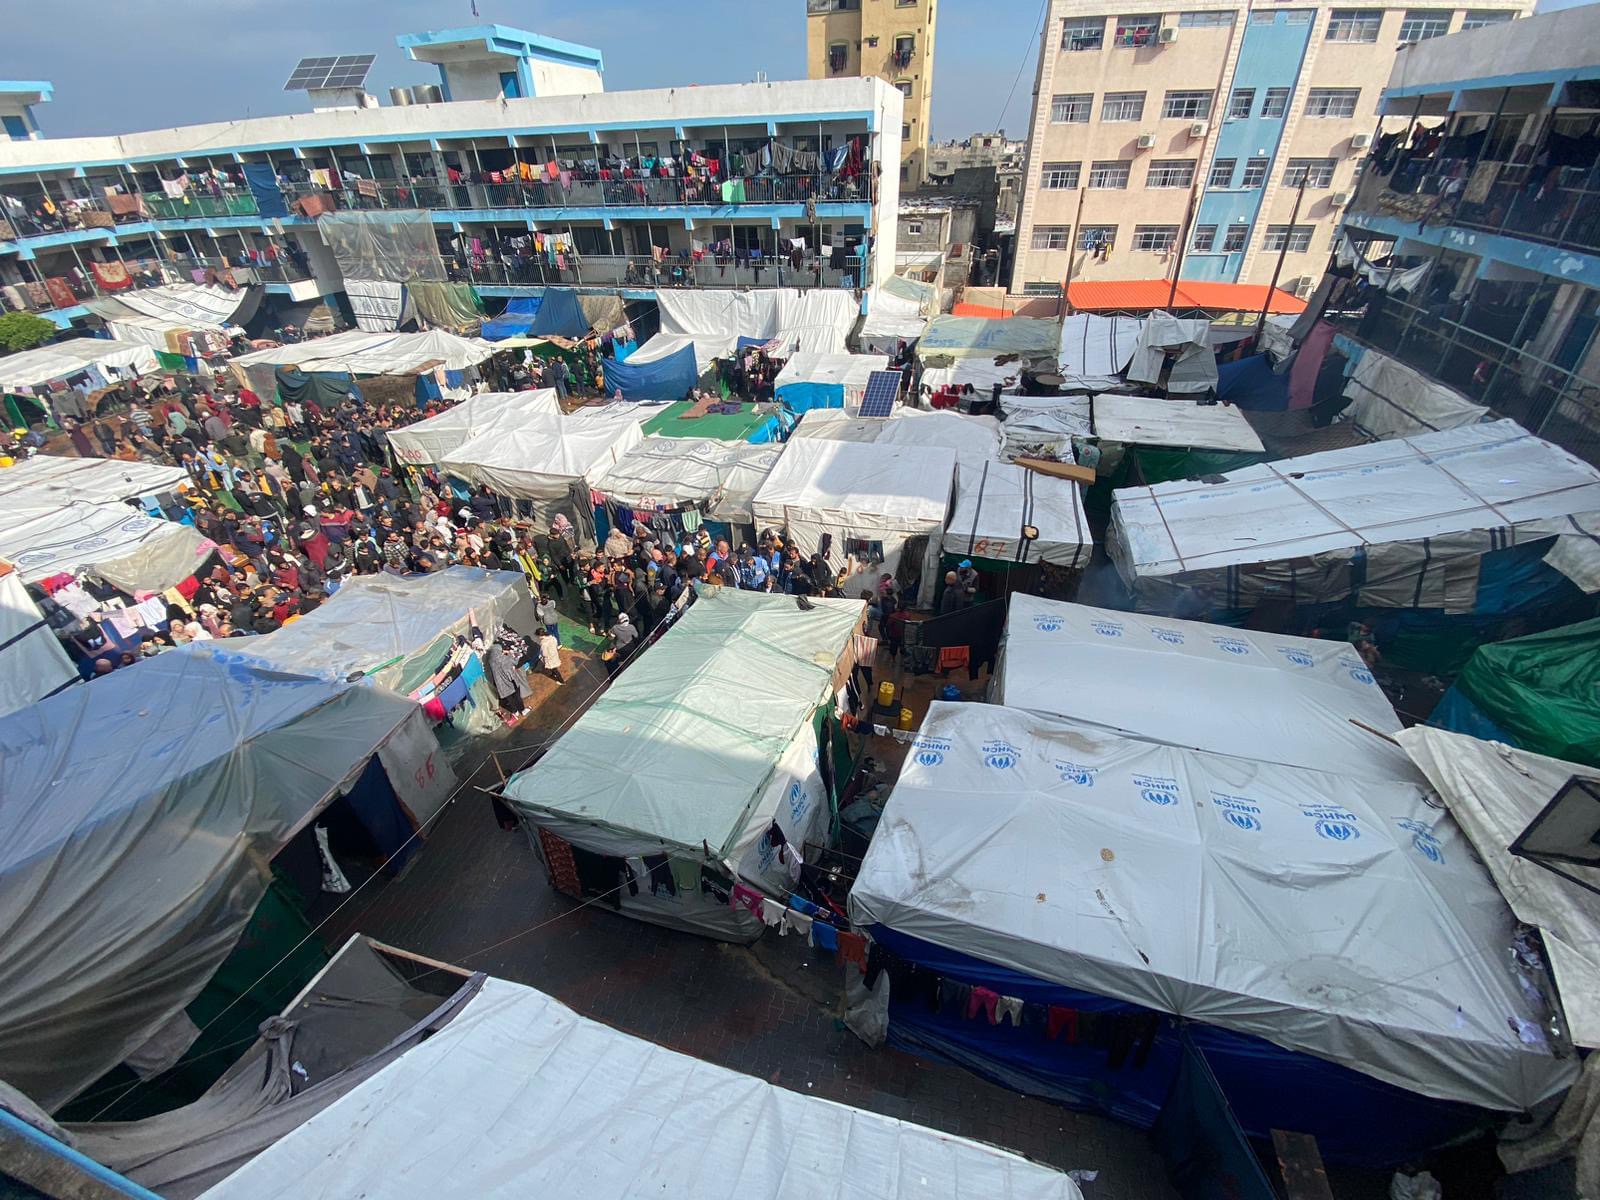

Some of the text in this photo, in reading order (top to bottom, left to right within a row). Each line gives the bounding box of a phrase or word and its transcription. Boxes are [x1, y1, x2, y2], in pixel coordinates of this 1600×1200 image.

[912, 741, 950, 751] UNHCR
[1133, 780, 1179, 792] UNHCR
[1213, 798, 1261, 814] UNHCR
[1303, 810, 1357, 822] UNHCR
